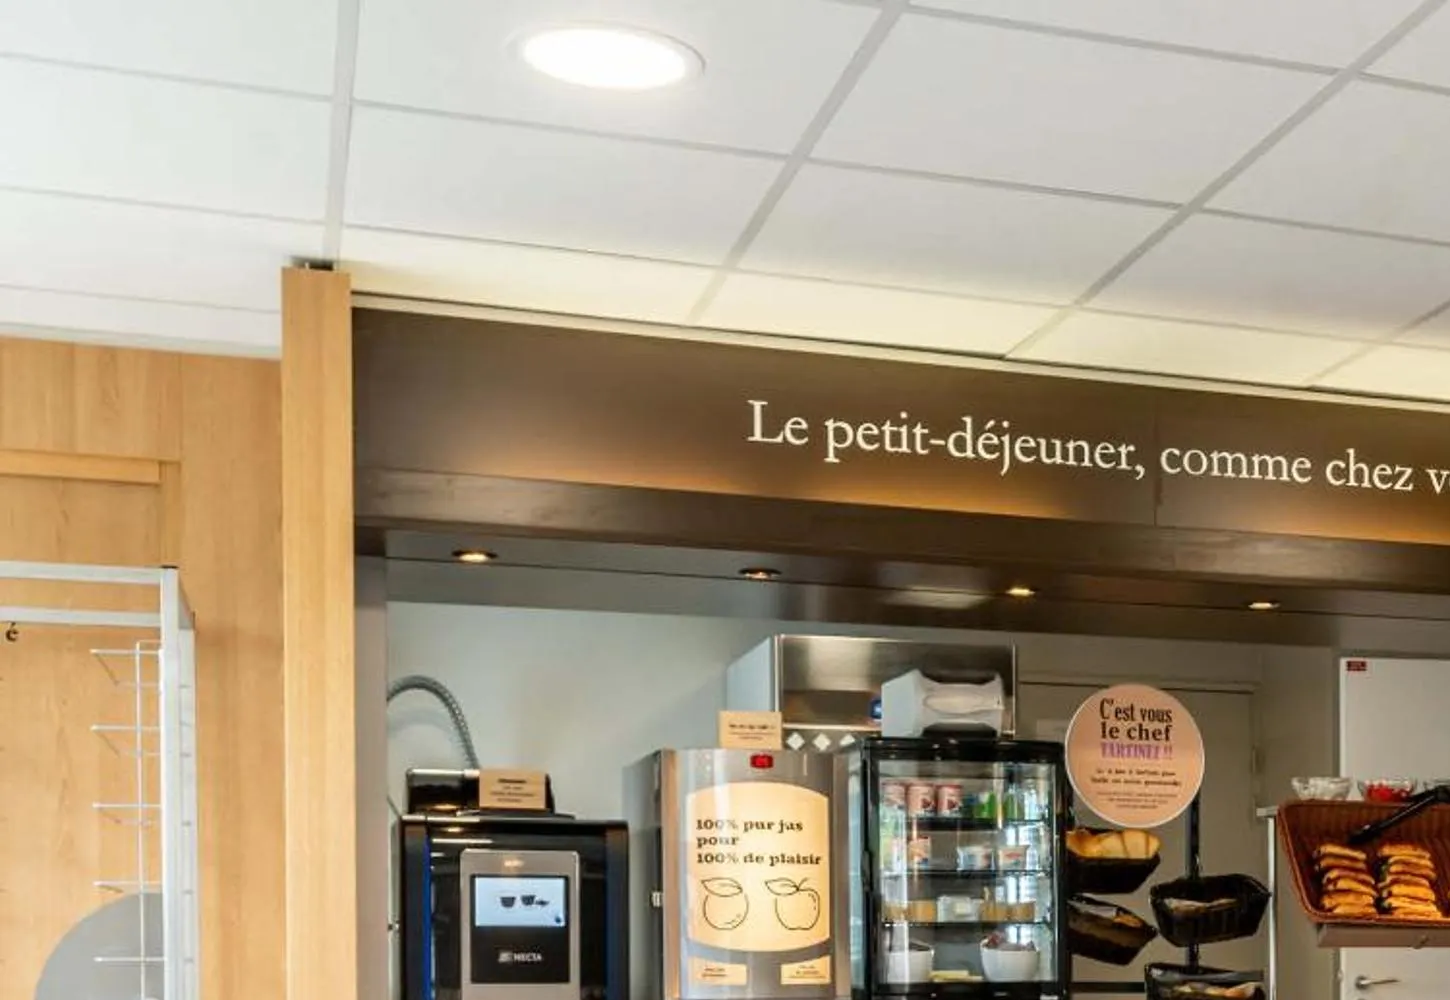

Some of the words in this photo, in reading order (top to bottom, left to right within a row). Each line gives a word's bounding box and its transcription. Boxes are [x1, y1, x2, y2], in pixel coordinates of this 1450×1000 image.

[747, 399, 809, 445] Le
[823, 408, 1147, 482] petit-déjeuner,
[1160, 441, 1313, 486] comme
[1326, 449, 1415, 493] chez
[1100, 698, 1135, 722] C'est
[1140, 708, 1173, 723] vous
[1101, 721, 1120, 740] le
[1127, 723, 1173, 742] chef
[696, 819, 739, 831] 100%
[743, 820, 775, 833] pur
[696, 836, 739, 849] pour
[696, 852, 739, 864] 100%
[743, 853, 765, 864] de
[769, 853, 822, 867] plaisir
